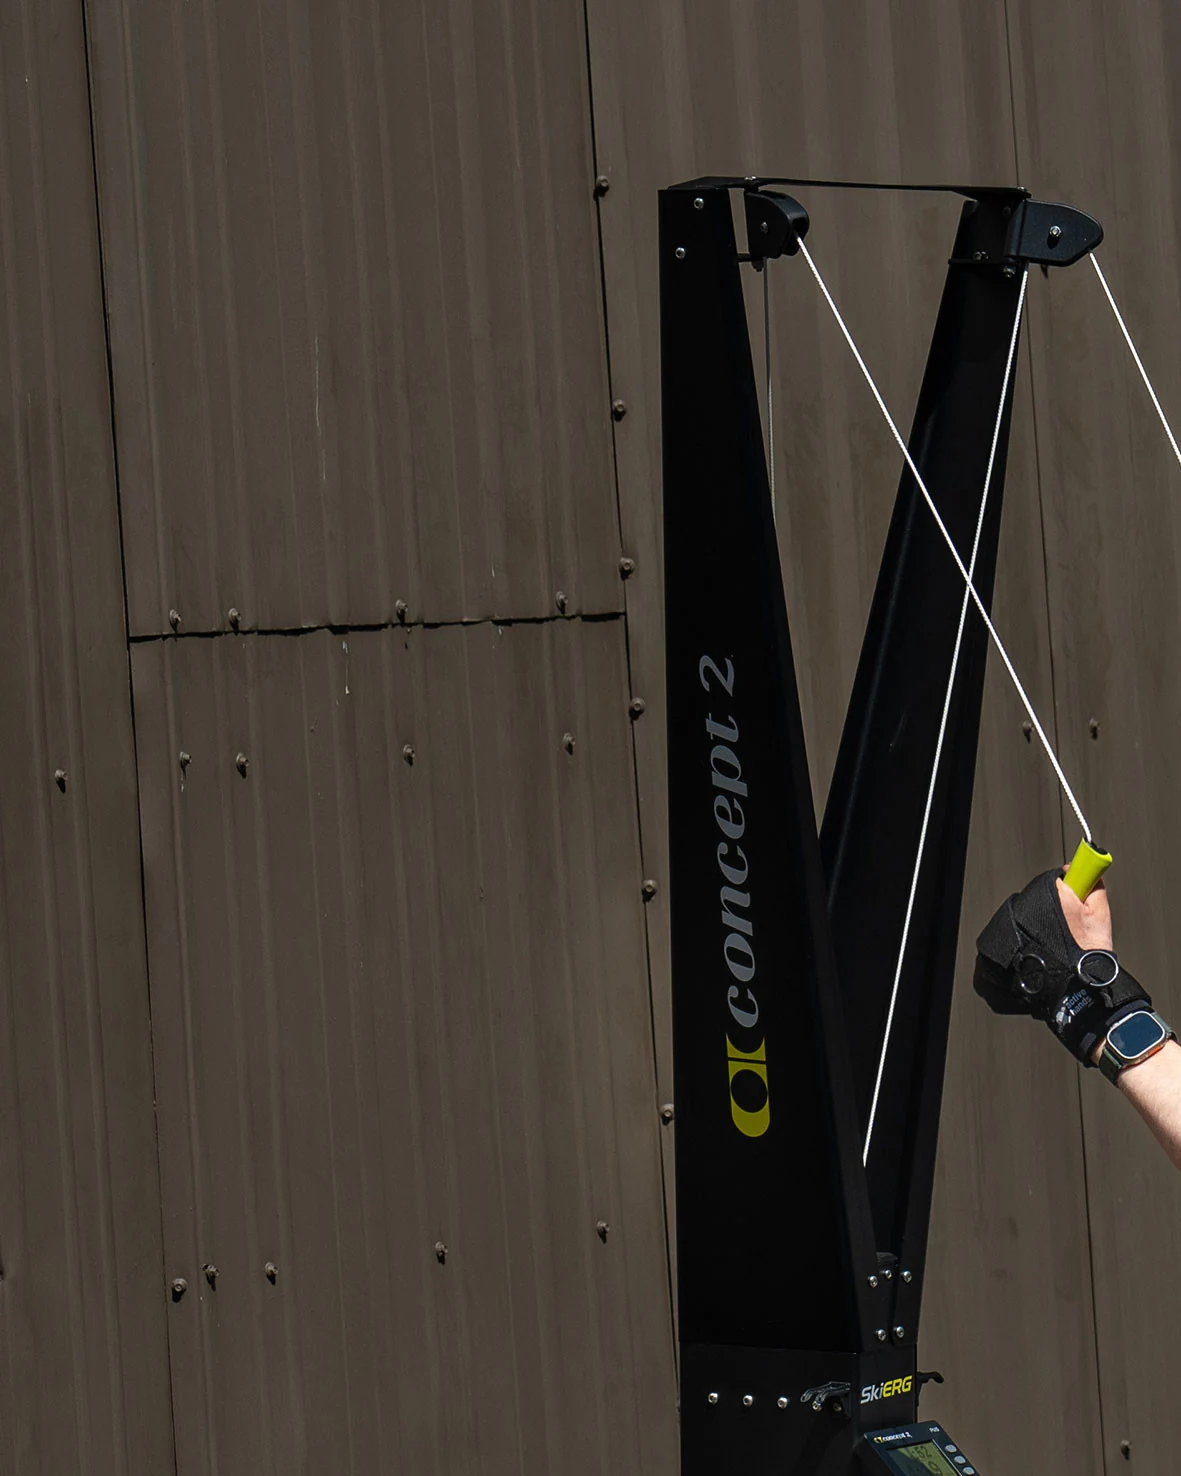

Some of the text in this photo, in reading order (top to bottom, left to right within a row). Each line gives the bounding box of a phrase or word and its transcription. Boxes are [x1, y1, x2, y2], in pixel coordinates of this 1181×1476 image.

[699, 654, 759, 1028] concept 2
[860, 1375, 913, 1405] SkiERG
